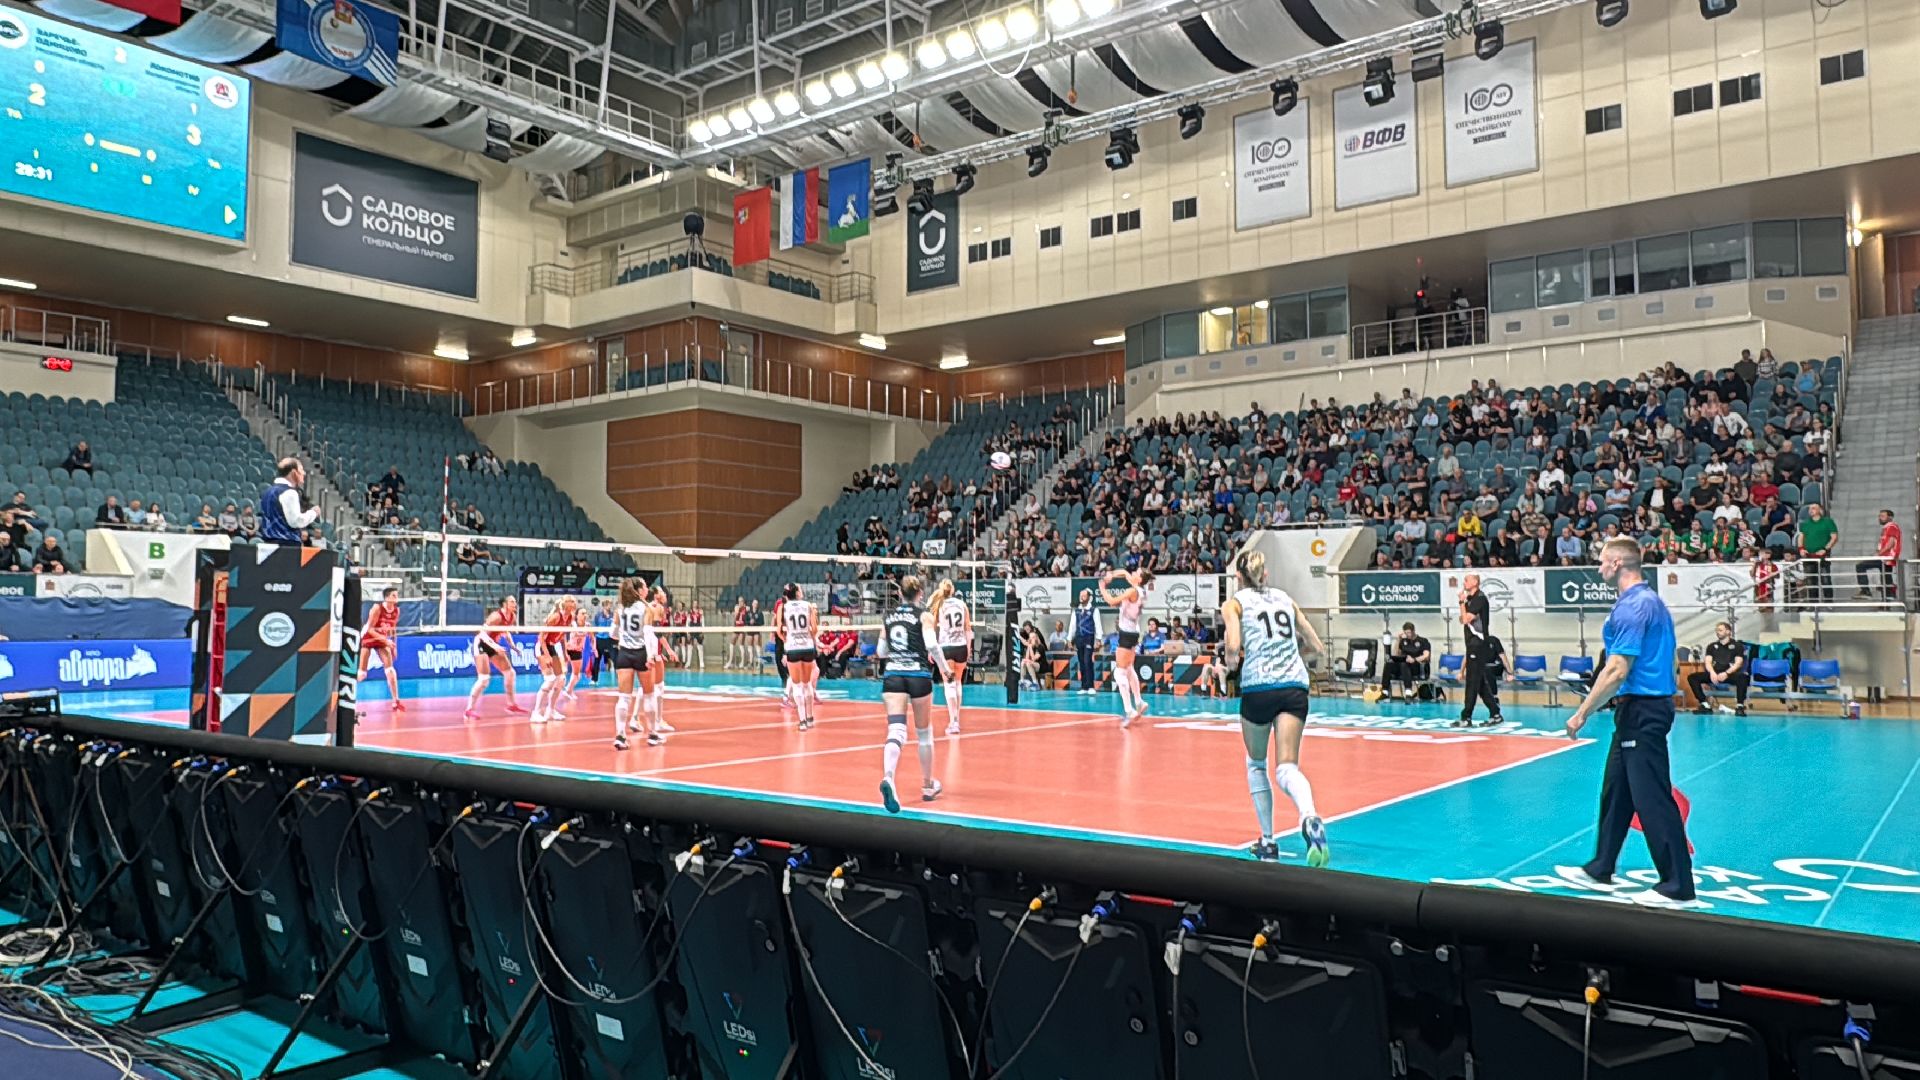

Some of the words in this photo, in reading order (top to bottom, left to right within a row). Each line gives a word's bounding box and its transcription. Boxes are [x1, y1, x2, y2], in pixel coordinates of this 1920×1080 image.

[28, 83, 46, 106] 2
[186, 124, 202, 146] 3
[1362, 122, 1406, 150] ВФВ
[362, 195, 456, 231] САДОВОЕ
[362, 213, 445, 246] КОЛЬЦО
[362, 235, 420, 254] ГЕНЕРАЛЬНЫЙ
[148, 542, 165, 560] B
[1310, 539, 1327, 557] C
[1378, 584, 1425, 595] САДОВОЕ
[1379, 594, 1419, 603] КОЛЬЦО
[621, 613, 640, 631] 15
[789, 613, 807, 630] 10
[945, 612, 963, 628] 12
[1257, 610, 1292, 638] 19
[338, 626, 361, 709] PARI
[723, 1020, 757, 1041] LEDsi
